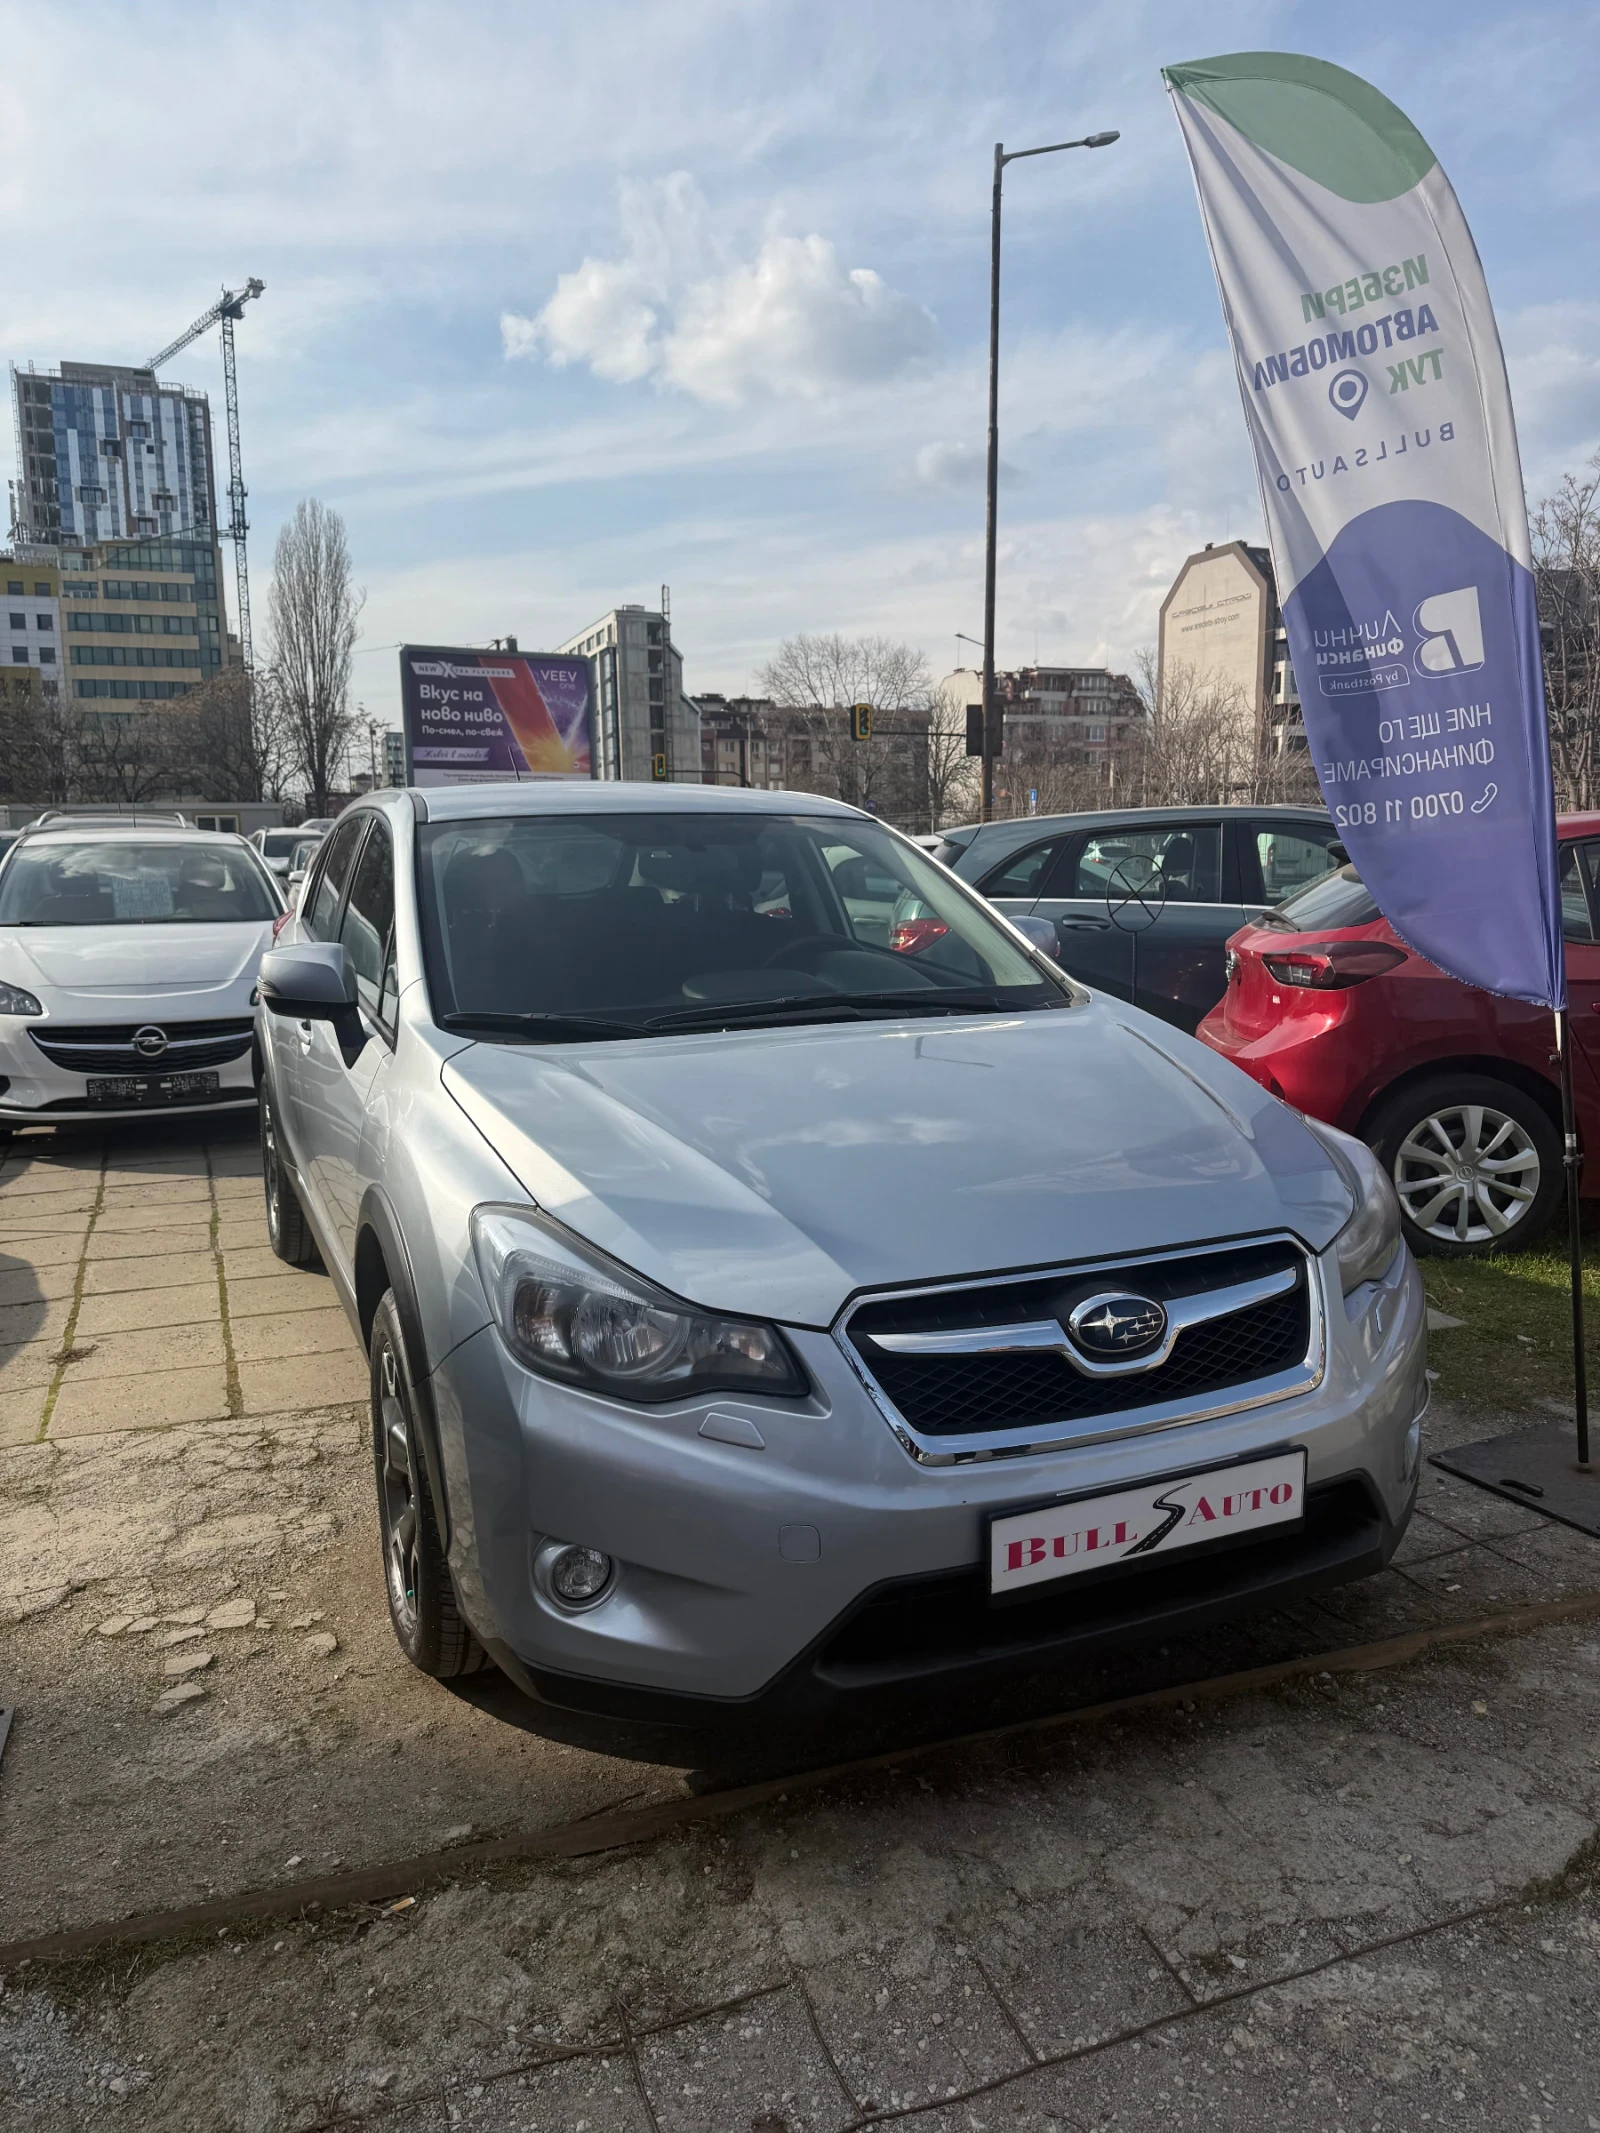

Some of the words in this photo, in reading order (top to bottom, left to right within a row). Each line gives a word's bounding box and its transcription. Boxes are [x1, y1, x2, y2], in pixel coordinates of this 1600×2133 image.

[418, 665, 437, 673] NEW
[540, 669, 578, 682] VEEV
[559, 682, 576, 690] one
[420, 684, 460, 704] Вкус
[463, 690, 483, 701] на
[421, 706, 461, 721] ново
[464, 708, 503, 722] ниво
[422, 725, 465, 737] По-смел,
[465, 728, 504, 737] по-свеж
[1003, 1520, 1138, 1573] BULL
[1185, 1482, 1293, 1527] AUTO
